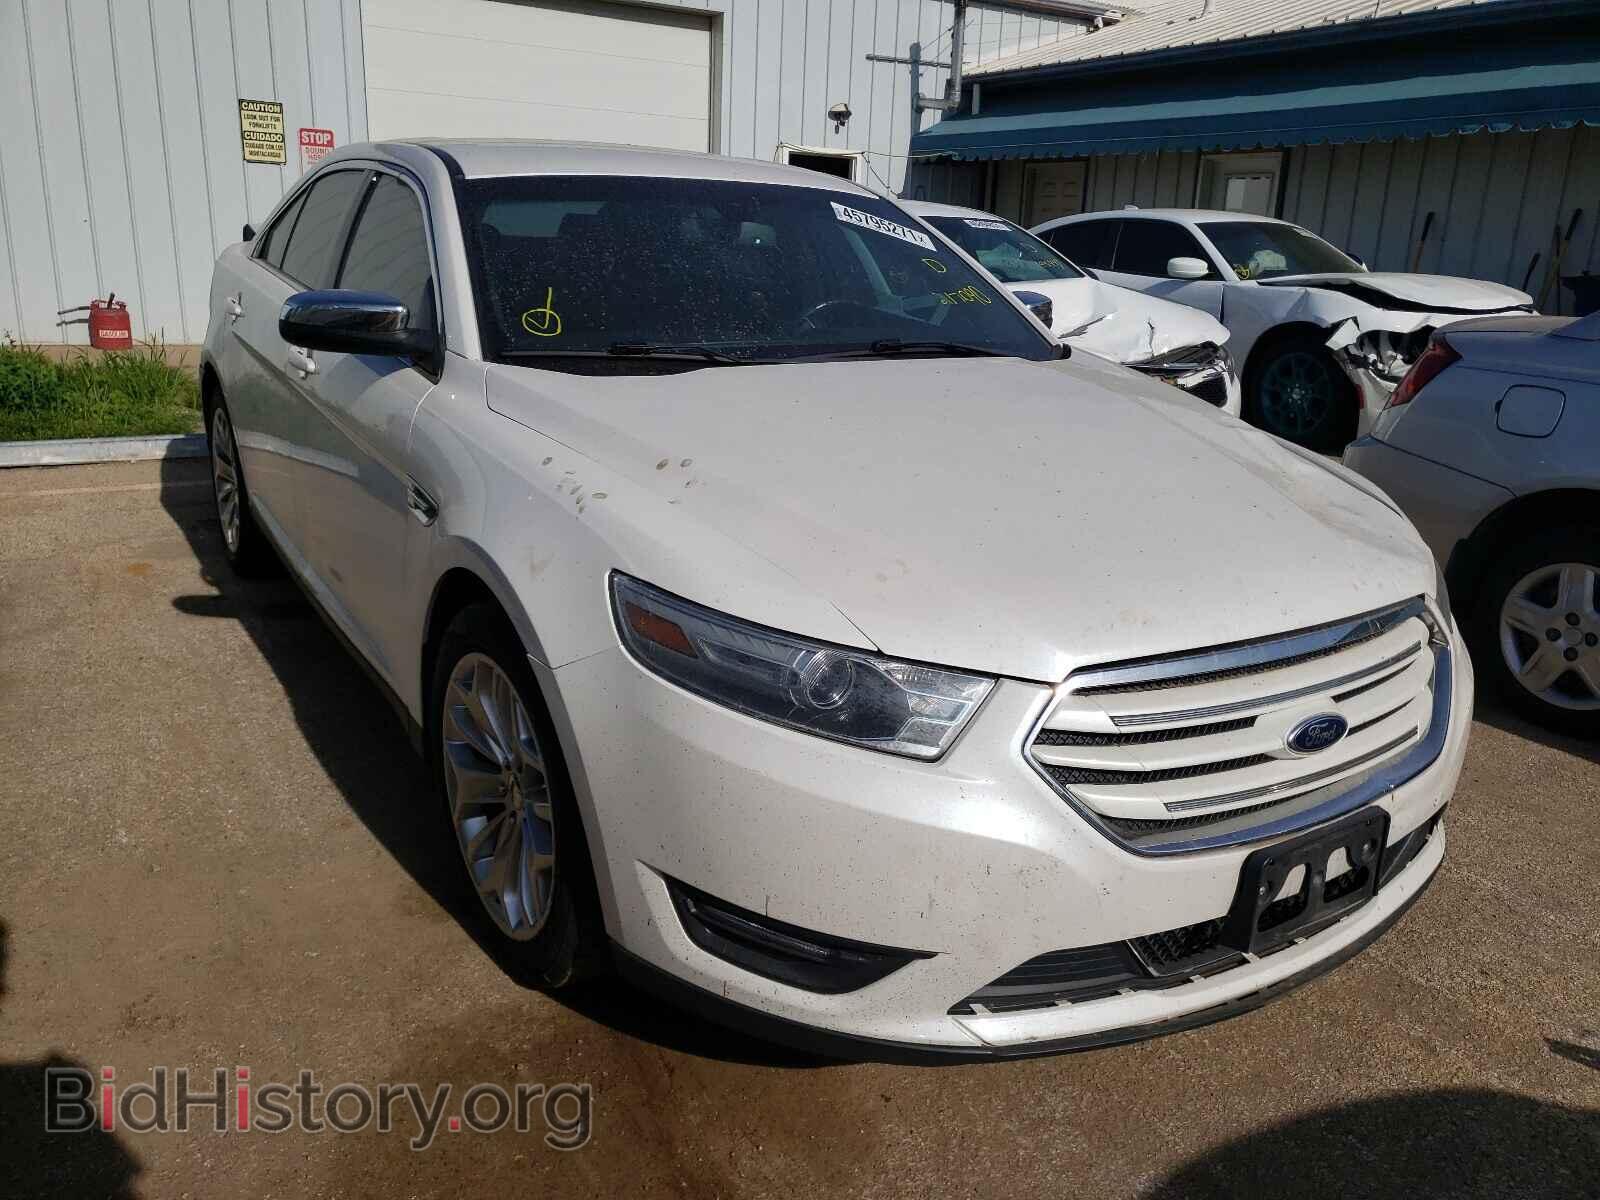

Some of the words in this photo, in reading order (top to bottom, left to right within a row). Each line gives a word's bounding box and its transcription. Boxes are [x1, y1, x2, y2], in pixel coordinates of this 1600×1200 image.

[241, 102, 281, 113] CAUTION
[243, 113, 257, 121] LOOK
[270, 115, 281, 123] FOR
[248, 121, 277, 130] FORKLIFTS
[244, 132, 283, 142] CUIDADO
[301, 131, 331, 145] STOP
[842, 206, 918, 243] 45795271
[1305, 721, 1338, 747] Ford
